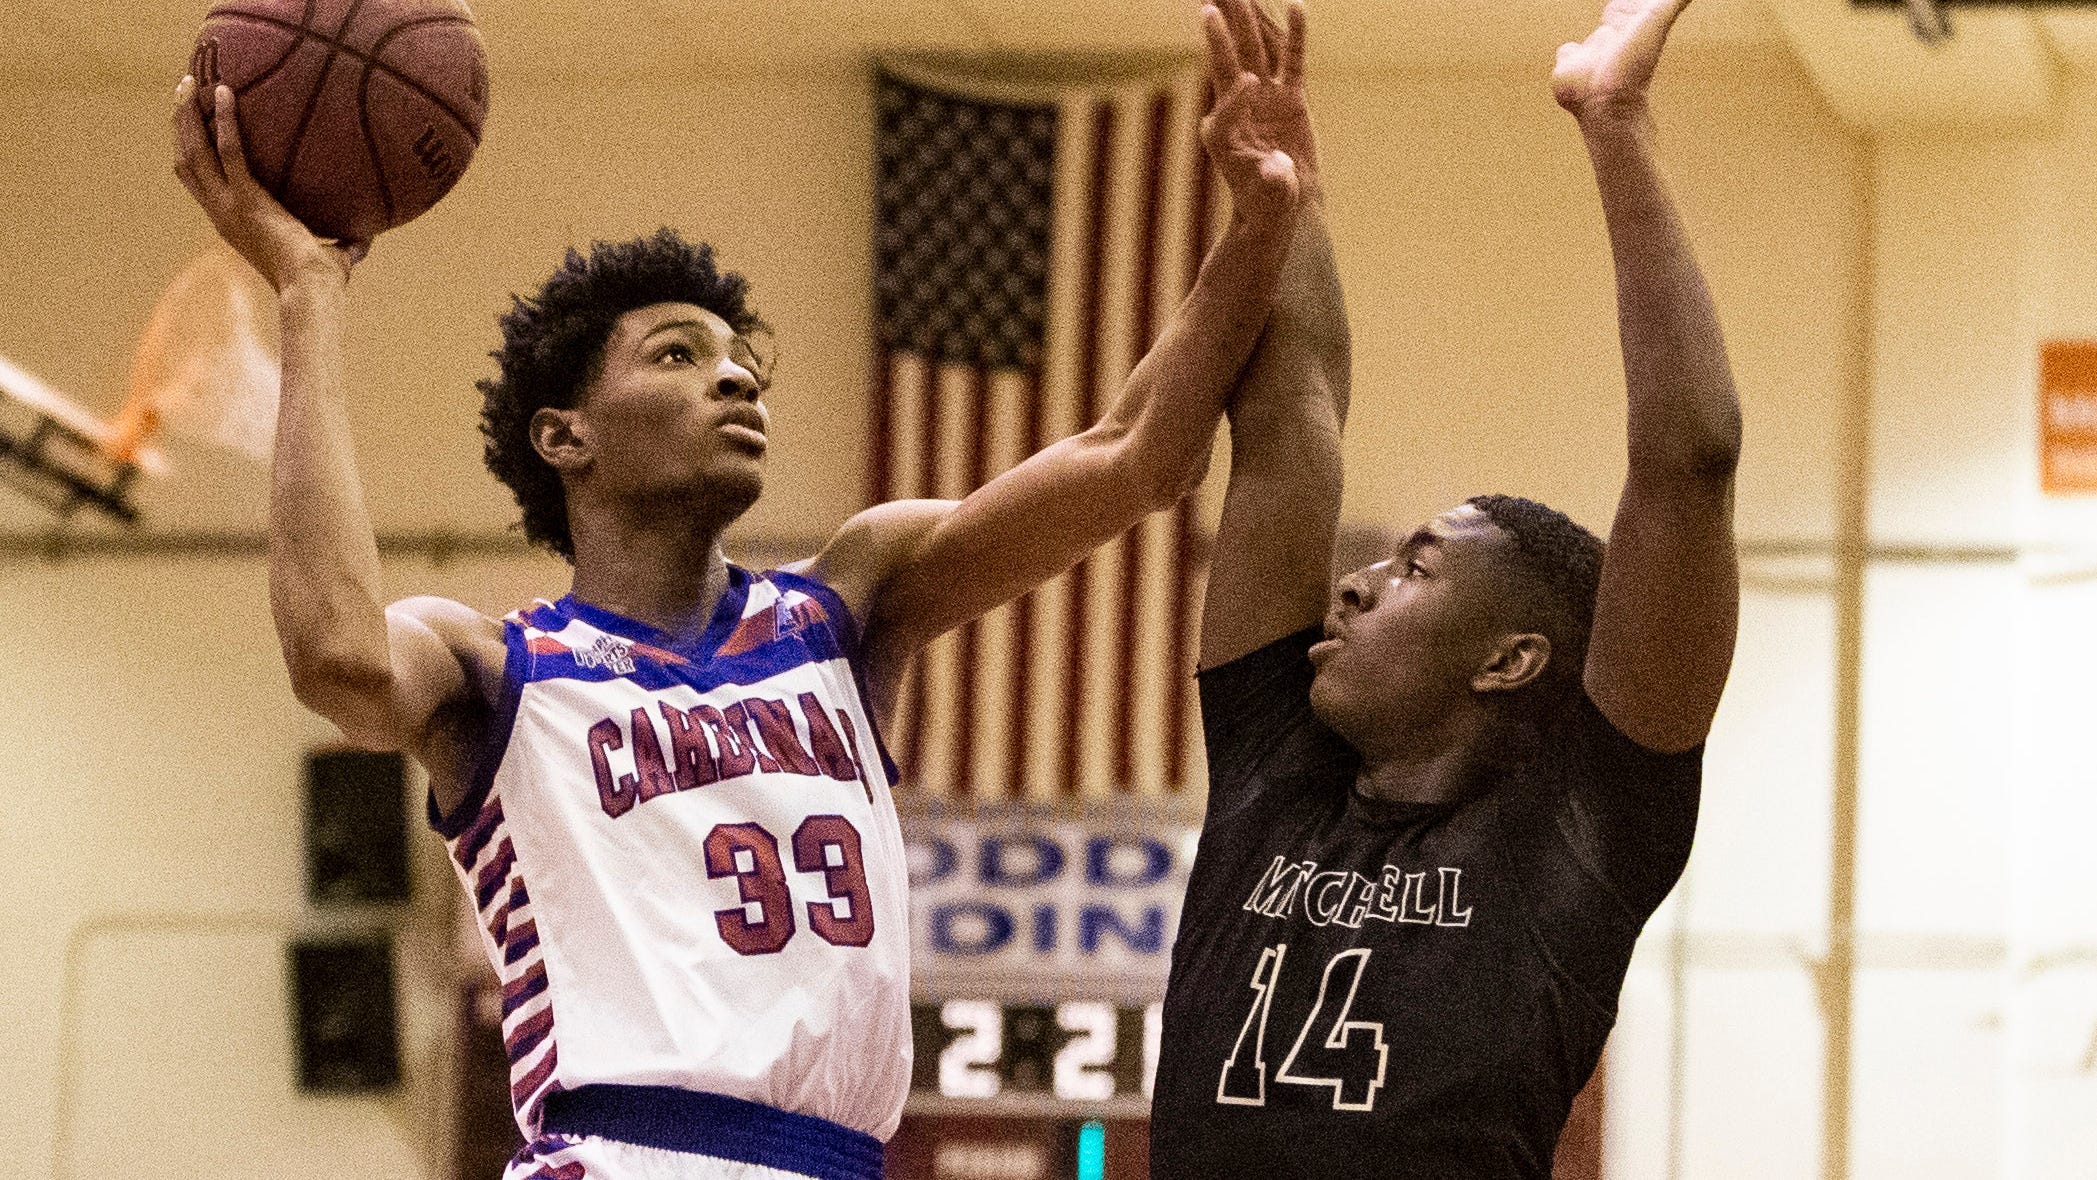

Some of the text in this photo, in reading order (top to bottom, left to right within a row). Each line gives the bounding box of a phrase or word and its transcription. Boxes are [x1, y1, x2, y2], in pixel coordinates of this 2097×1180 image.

[702, 813, 875, 956] 33
[1242, 855, 1473, 928] MTCHELL
[1216, 943, 1389, 1112] 14
